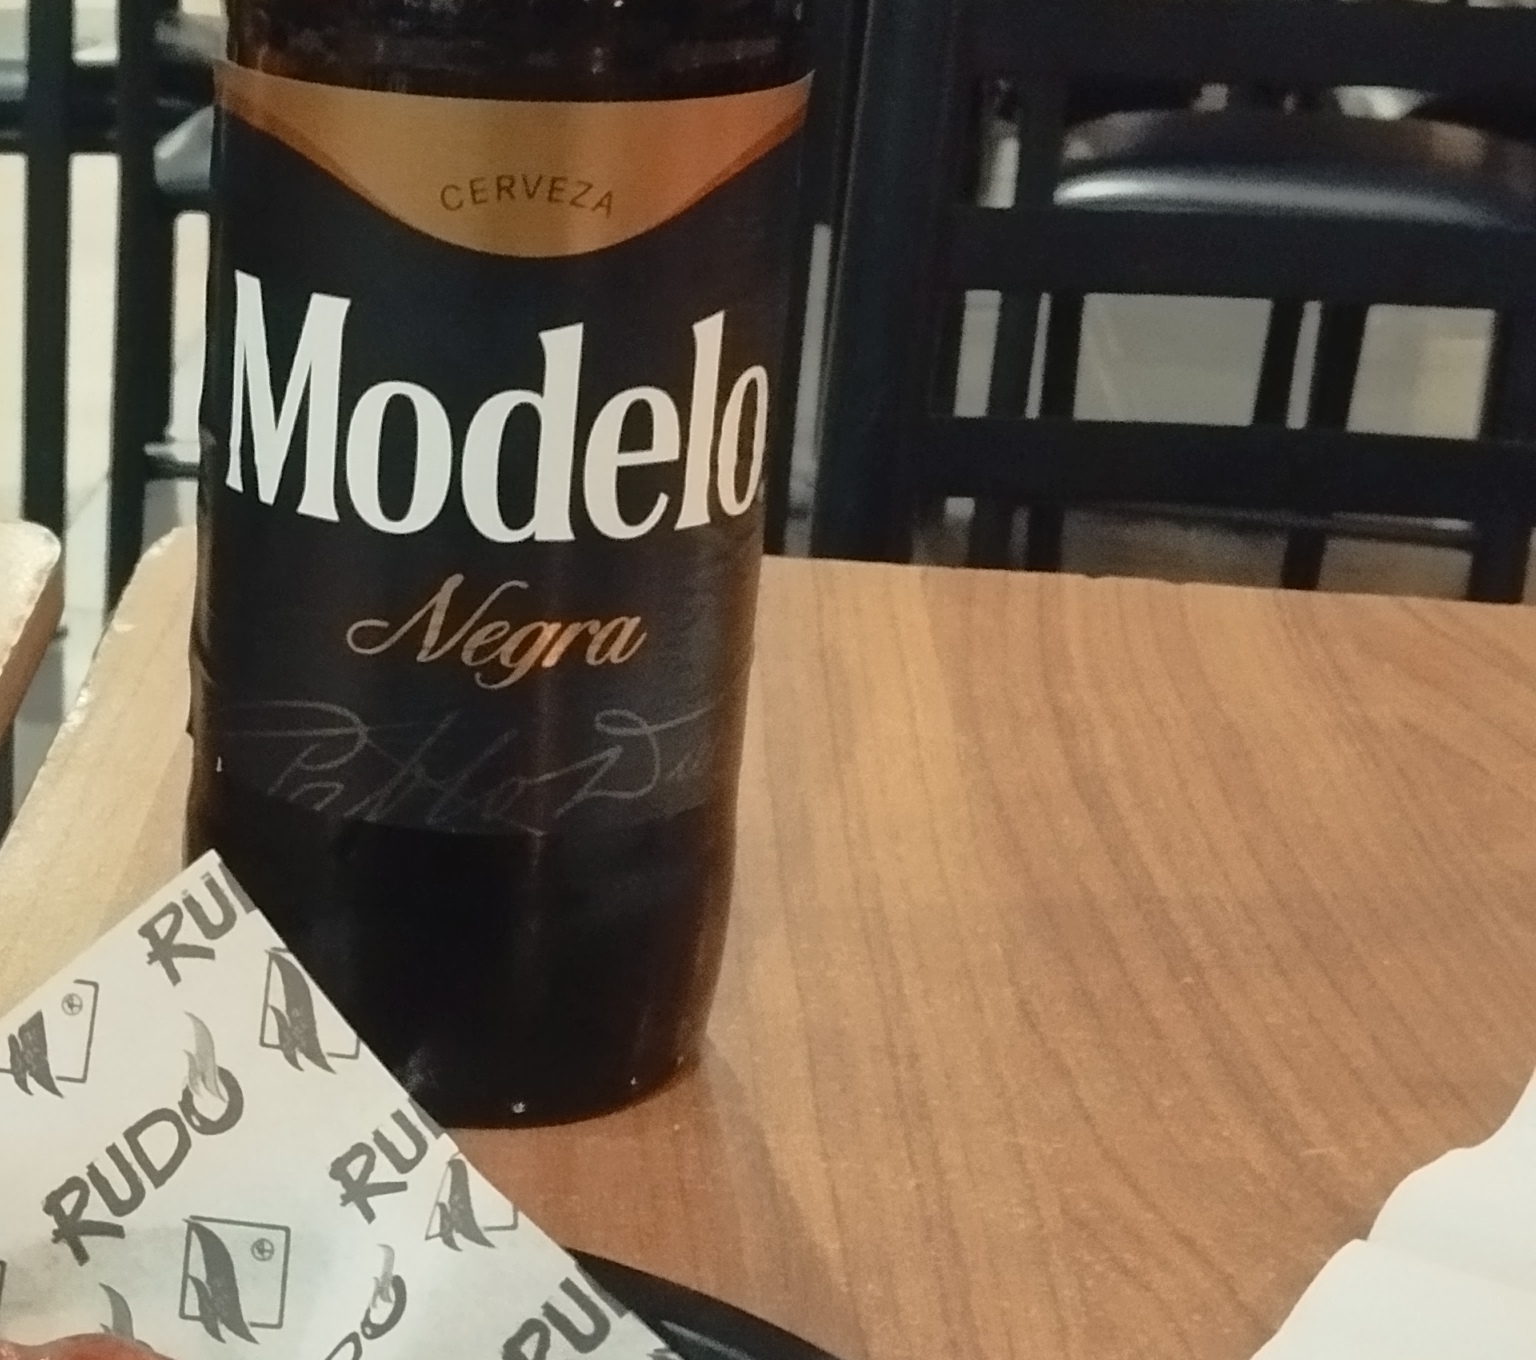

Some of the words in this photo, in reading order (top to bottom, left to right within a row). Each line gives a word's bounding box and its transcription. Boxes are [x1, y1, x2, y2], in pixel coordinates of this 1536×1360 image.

[440, 173, 614, 220] CERVEZA
[225, 269, 770, 544] Modelo
[346, 572, 648, 690] Negra
[42, 1064, 245, 1267] RUDO
